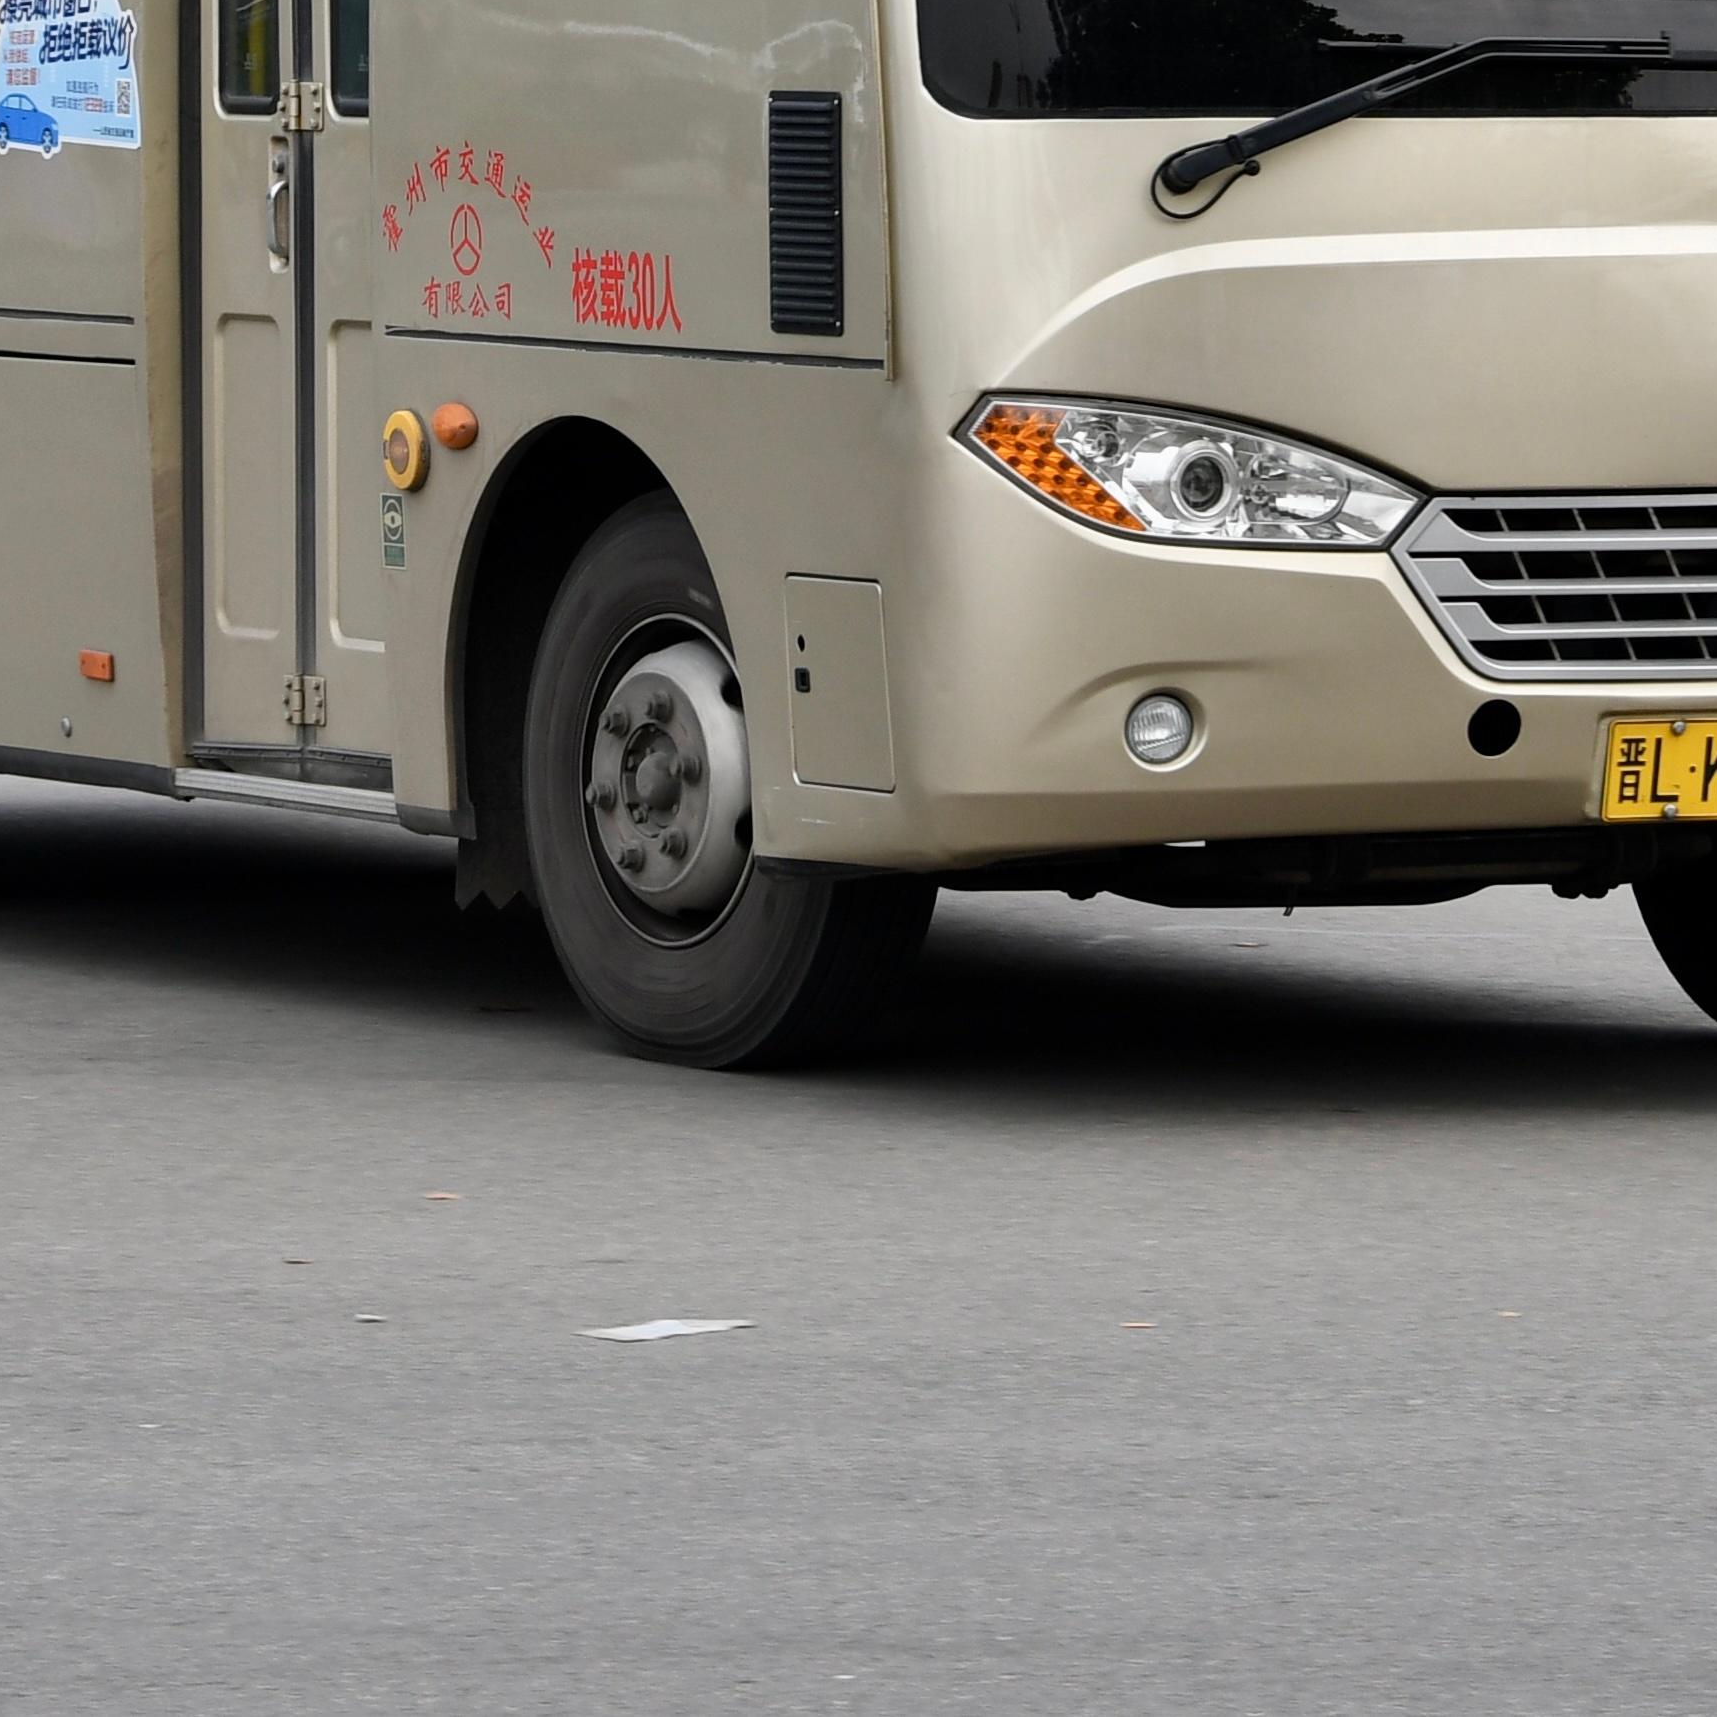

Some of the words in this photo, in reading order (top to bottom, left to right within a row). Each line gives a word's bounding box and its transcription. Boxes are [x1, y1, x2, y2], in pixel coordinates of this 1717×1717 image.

[39, 15, 134, 69] 拒绝拒载议价
[422, 276, 512, 320] 有限公司
[571, 248, 682, 333] 核载30人
